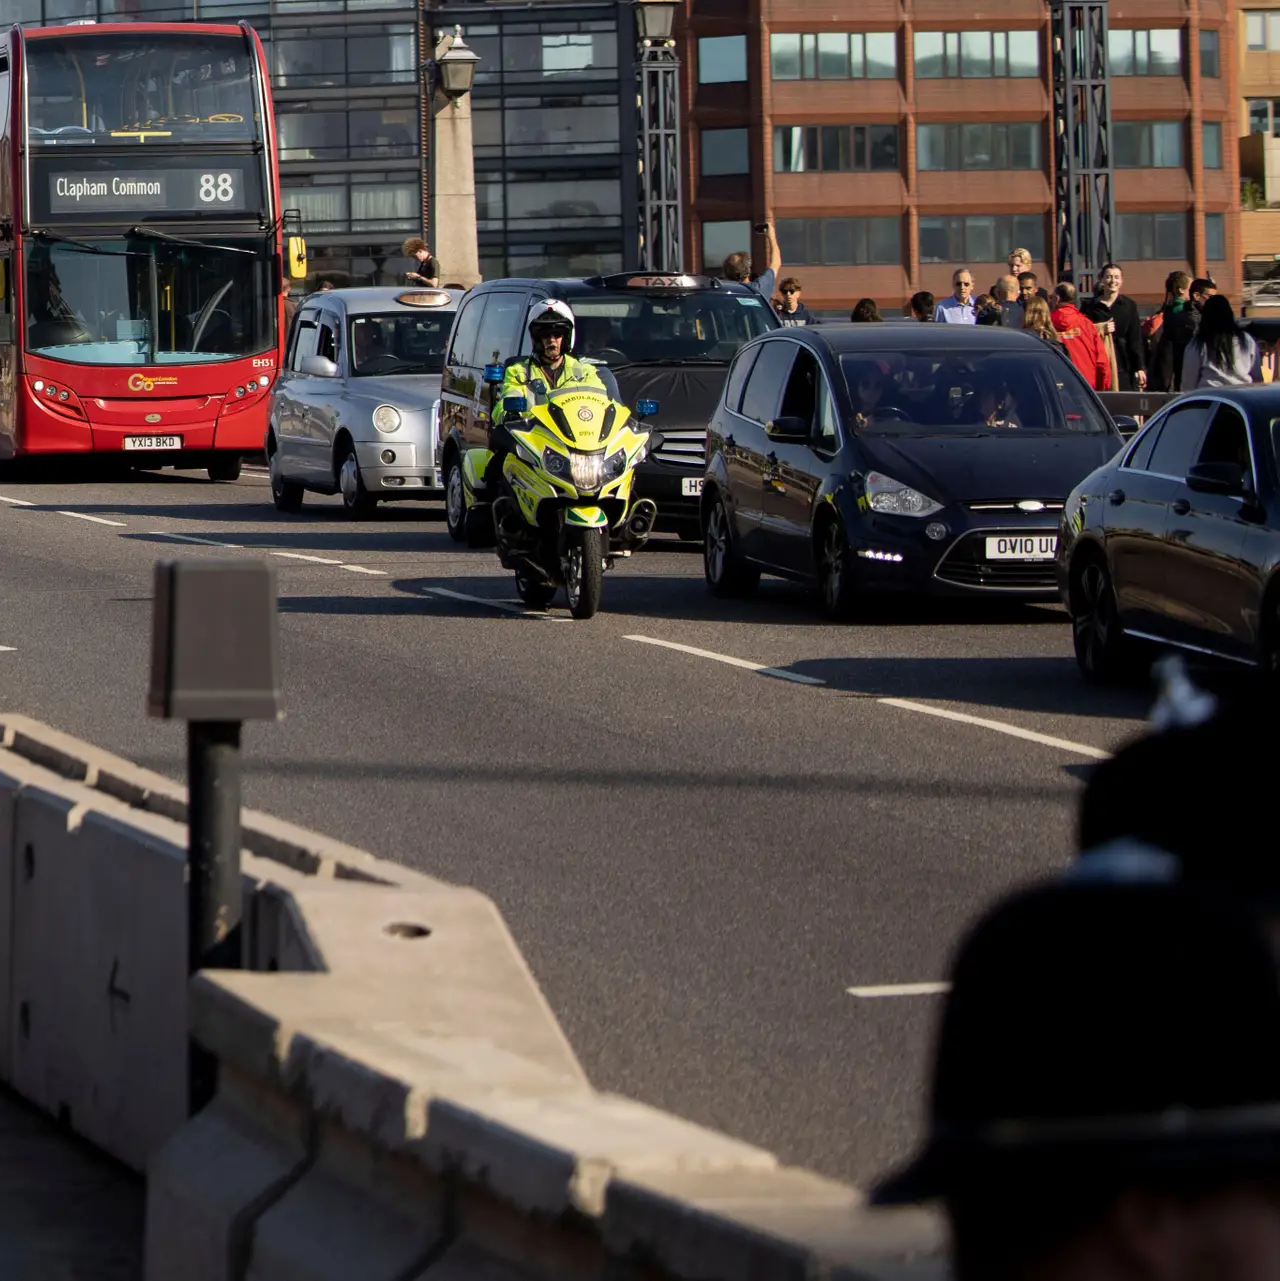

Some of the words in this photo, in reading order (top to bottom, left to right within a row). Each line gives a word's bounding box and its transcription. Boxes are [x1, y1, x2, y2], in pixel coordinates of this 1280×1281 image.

[56, 178, 108, 201] Clapham
[112, 177, 161, 196] Common
[199, 173, 234, 202] 88
[640, 277, 684, 287] TAXI
[252, 358, 274, 368] EH31
[561, 395, 606, 407] AMBULANCE
[131, 437, 153, 448] YX13
[156, 437, 175, 448] BKD
